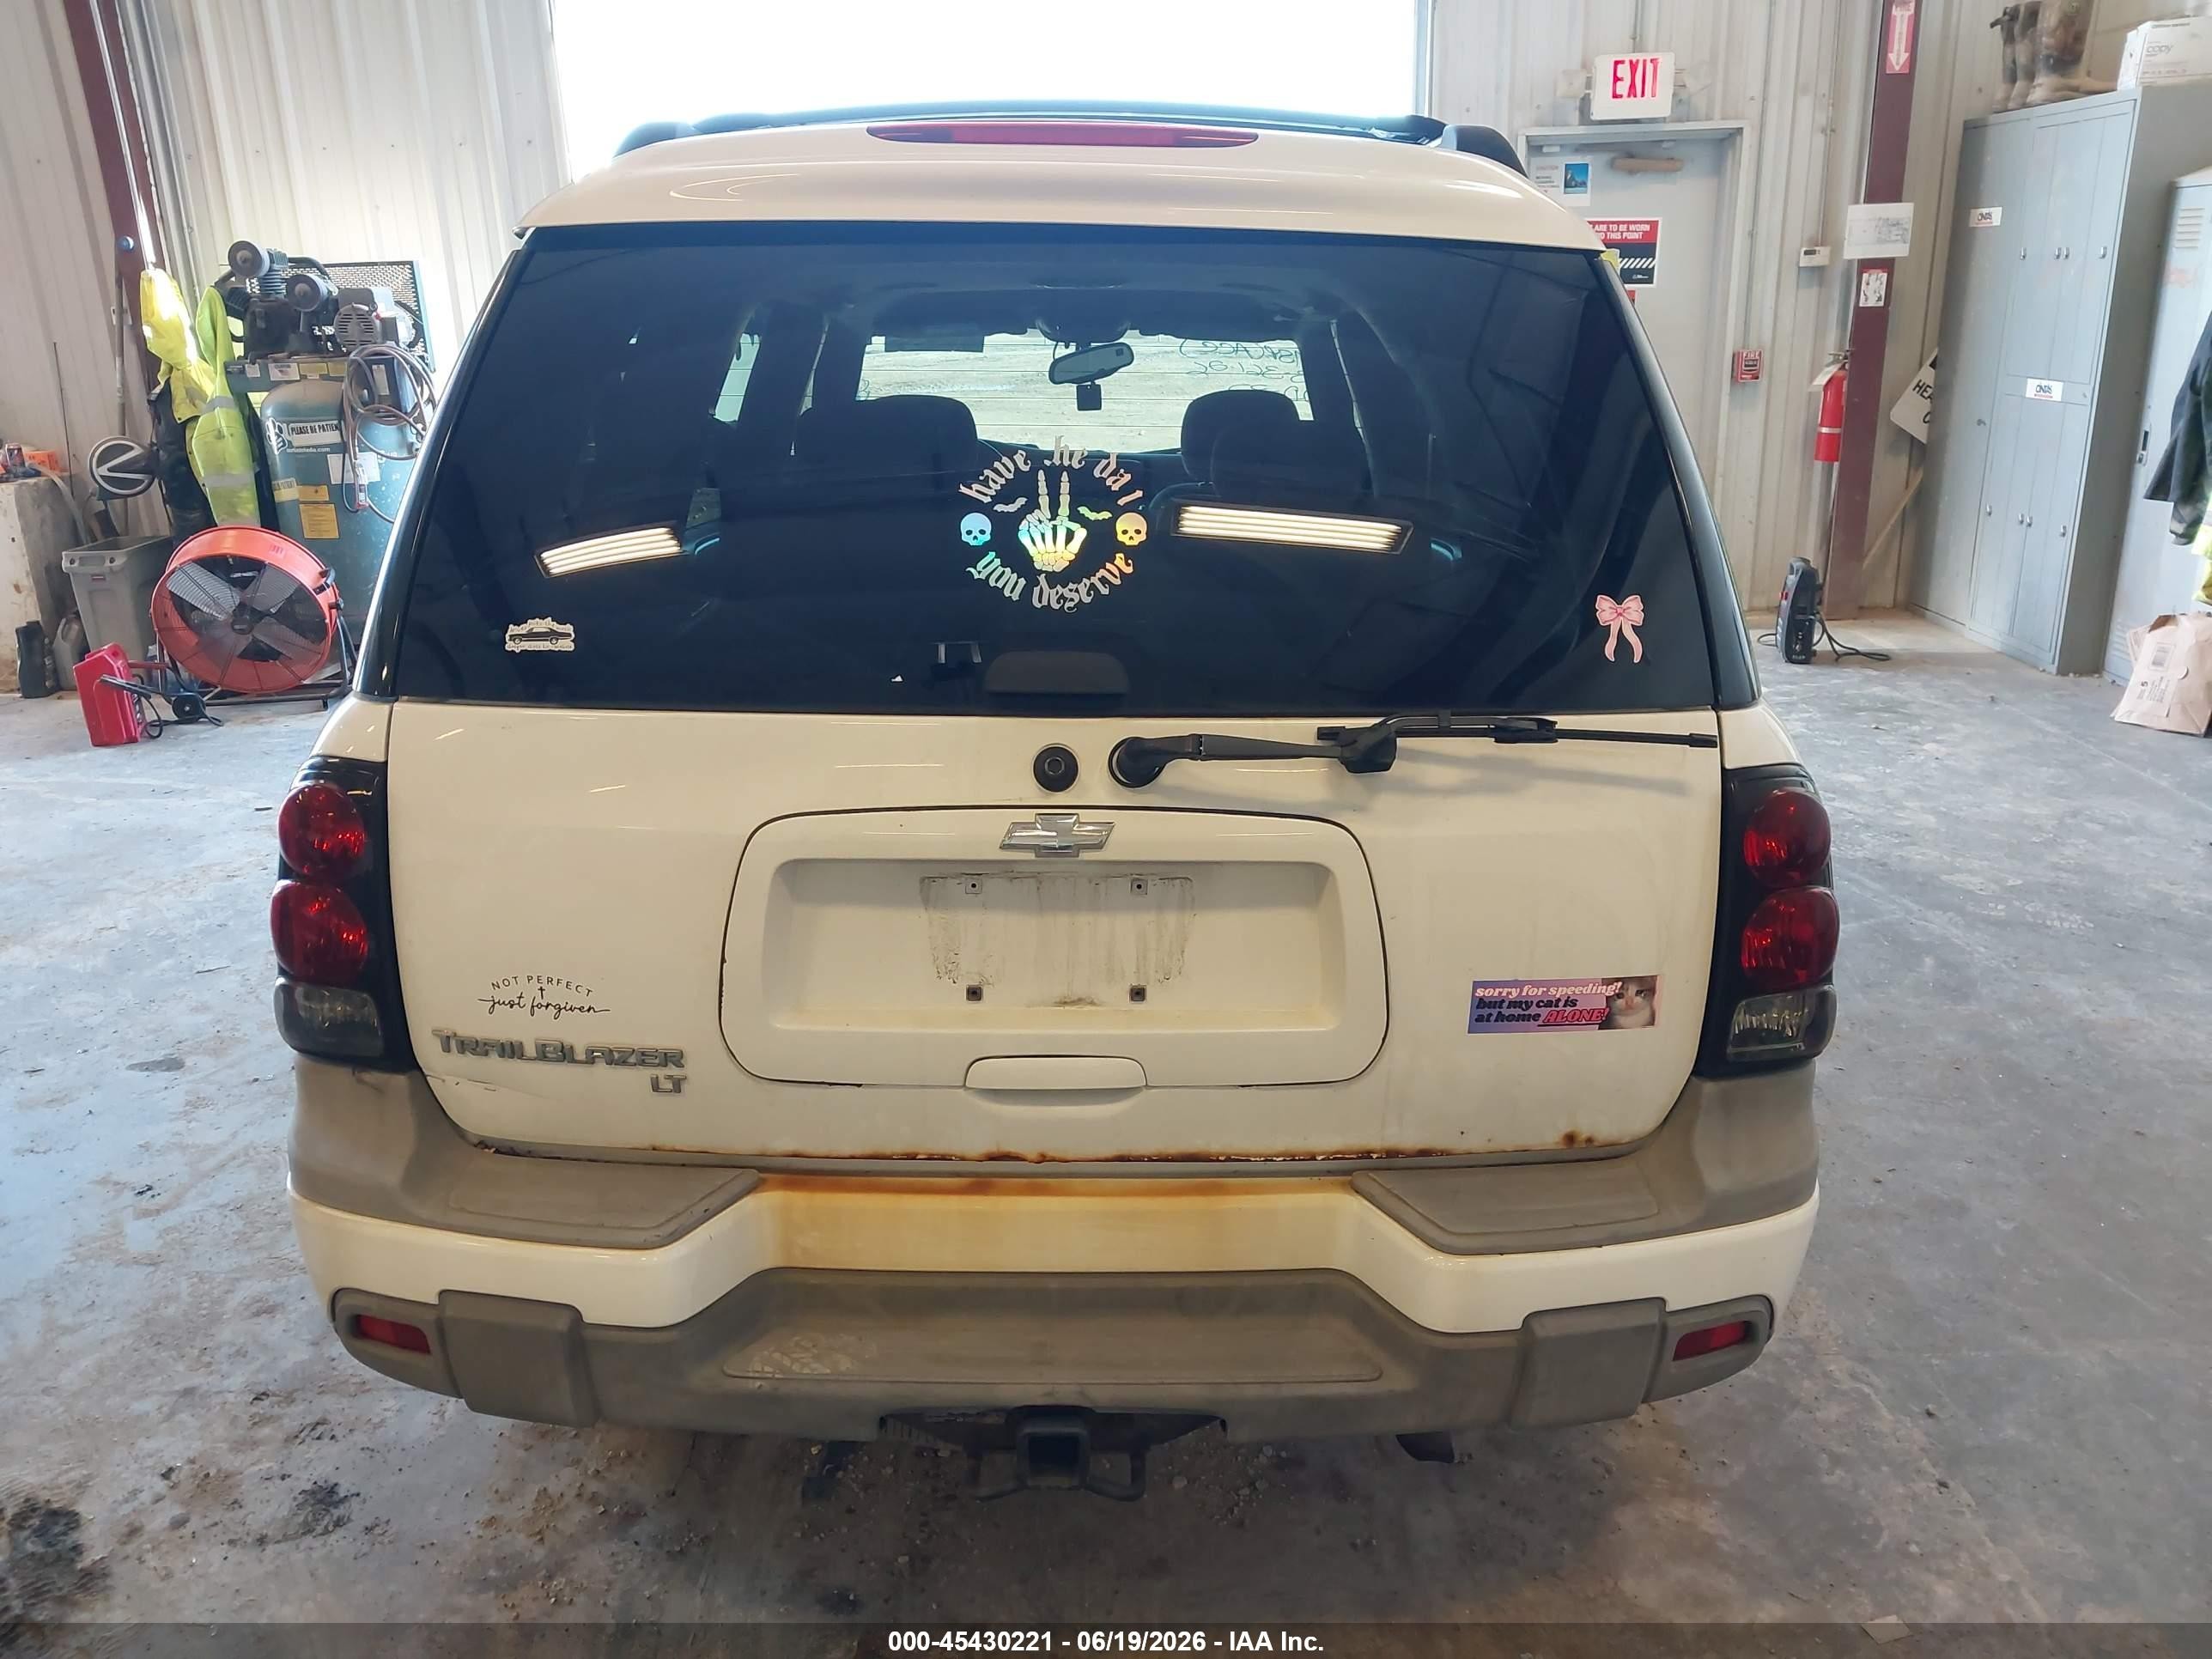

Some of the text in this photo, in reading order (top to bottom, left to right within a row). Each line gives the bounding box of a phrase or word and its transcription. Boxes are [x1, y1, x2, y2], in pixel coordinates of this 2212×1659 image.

[1612, 58, 1660, 99] EXIT
[291, 425, 310, 435] PLEASE
[310, 424, 318, 434] BE
[958, 450, 1031, 503] have
[965, 551, 1133, 613] you deserve
[491, 975, 593, 997] NOT PERFECT
[1475, 981, 1623, 999] sorry for speeding!
[477, 991, 611, 1020] just forgiven
[1476, 996, 1578, 1011] but my cat is
[1474, 1008, 1610, 1024] at home ALONE!
[650, 1073, 687, 1093] LT
